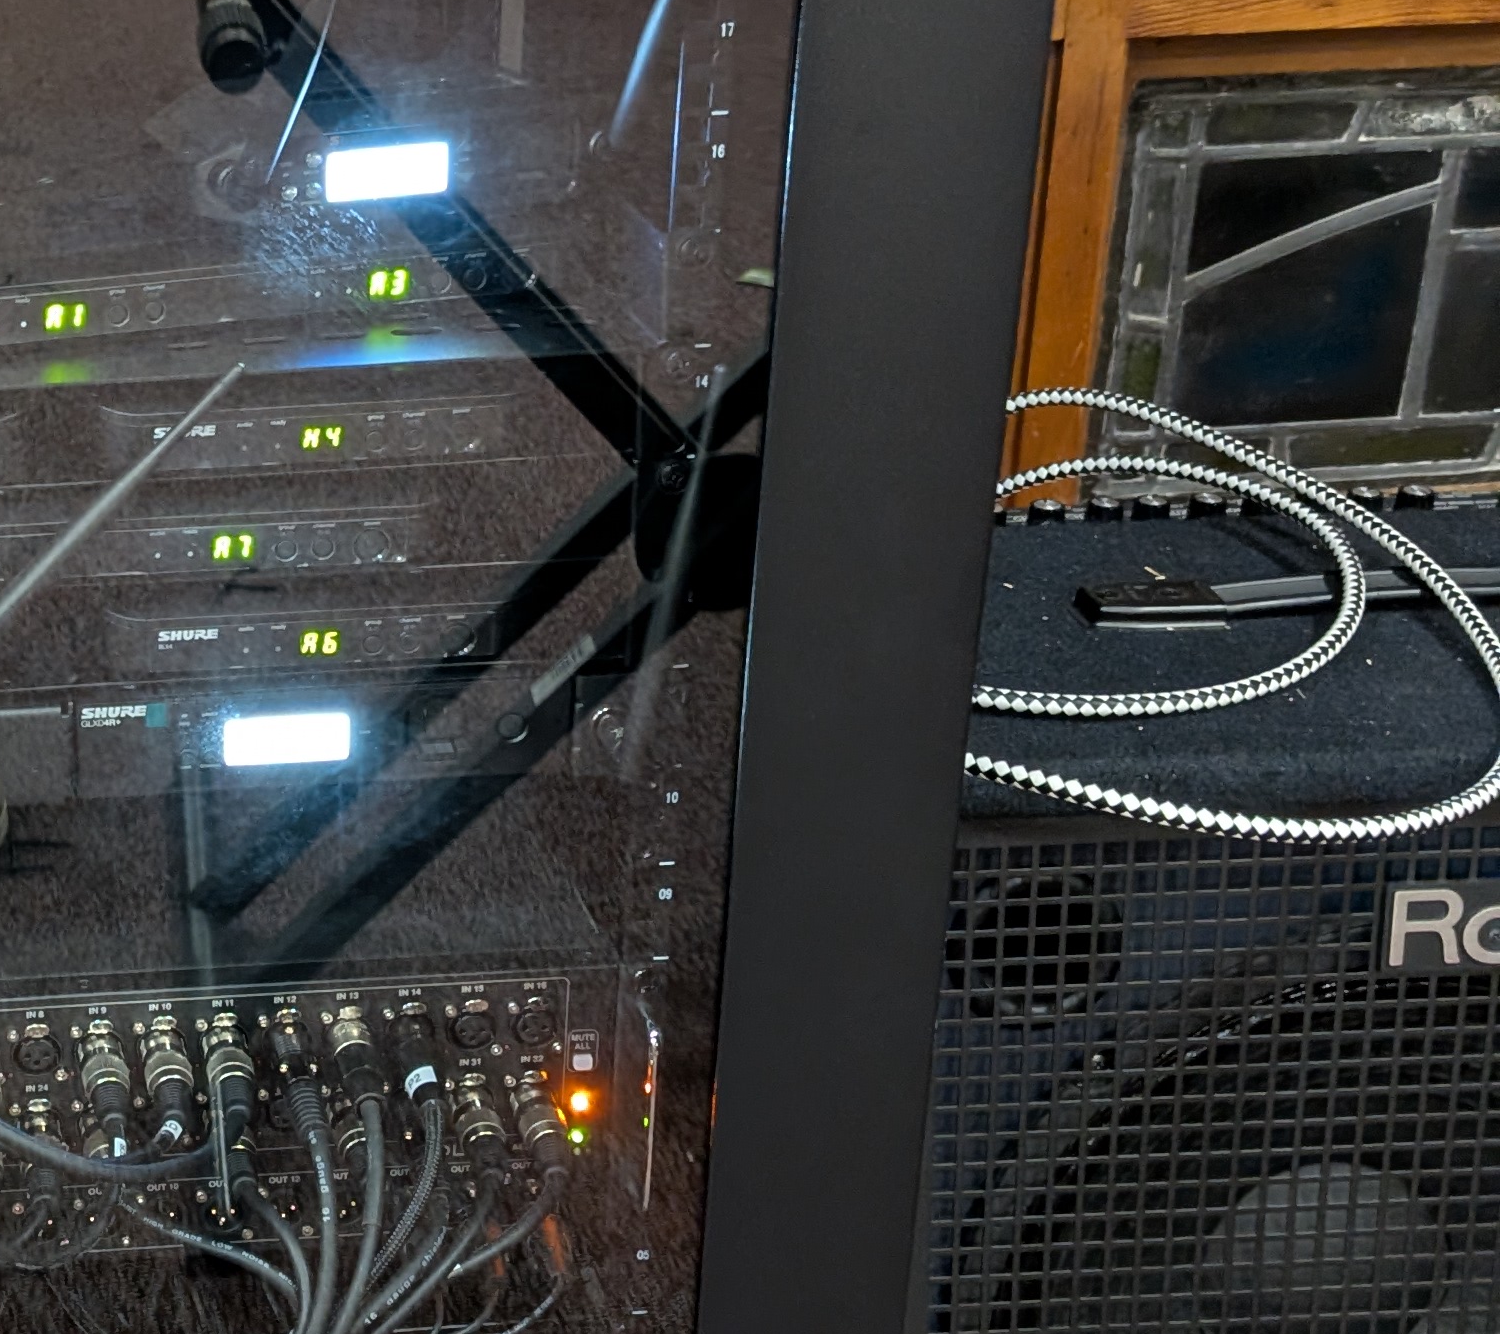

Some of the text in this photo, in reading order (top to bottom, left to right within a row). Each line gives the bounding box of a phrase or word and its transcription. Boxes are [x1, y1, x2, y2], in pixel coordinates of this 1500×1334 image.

[721, 22, 735, 37] 17
[712, 144, 725, 158] 16
[695, 375, 708, 388] 14
[153, 425, 216, 439] SRE
[158, 629, 219, 642] SHURE
[300, 631, 338, 655] A6
[81, 705, 147, 719] SHURE
[665, 791, 679, 804] 10
[658, 888, 672, 900] 09
[411, 988, 421, 996] 14
[226, 999, 234, 1007] 11
[572, 1033, 596, 1042] MUTE
[575, 1042, 591, 1050] ALL
[521, 1056, 532, 1064] IN
[407, 1074, 421, 1092] P2
[147, 1183, 167, 1191] OUT
[268, 1177, 288, 1185] OUT
[171, 1229, 202, 1242] GRADE
[211, 1240, 233, 1251] LOW
[636, 1250, 649, 1261] 05
